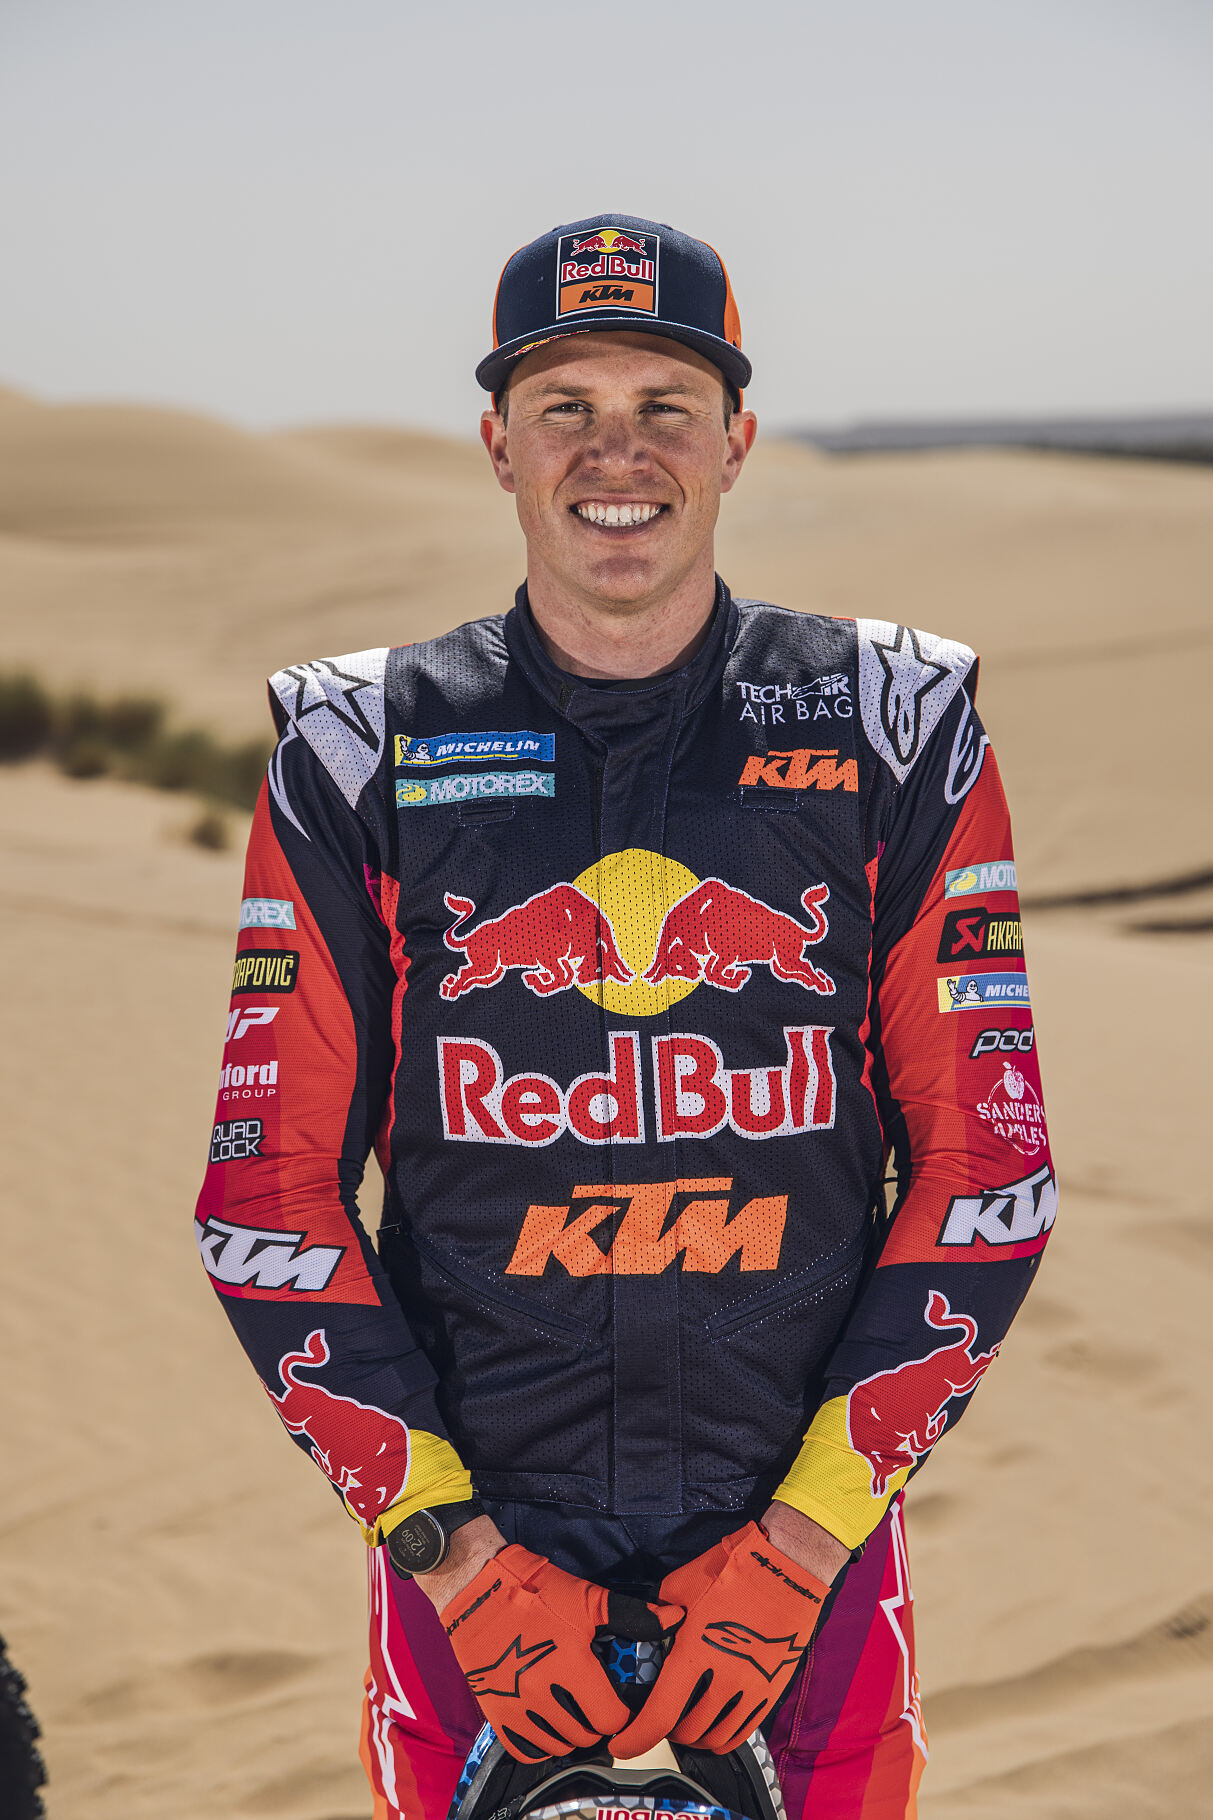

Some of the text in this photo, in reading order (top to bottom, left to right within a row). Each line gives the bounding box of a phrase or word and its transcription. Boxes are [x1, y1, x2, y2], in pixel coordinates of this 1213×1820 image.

[561, 255, 654, 283] Red Bull
[579, 285, 634, 304] KTM
[796, 696, 853, 721] BAG
[436, 740, 540, 757] MICHELIN
[738, 749, 858, 793] KTM
[430, 774, 548, 802] MOTOREX
[971, 1026, 1034, 1058] pod
[222, 1089, 276, 1101] GROUP
[436, 1025, 837, 1147] Red Bull
[212, 1120, 261, 1143] QUAD
[210, 1139, 260, 1162] LOCK
[504, 1177, 788, 1277] KTM
